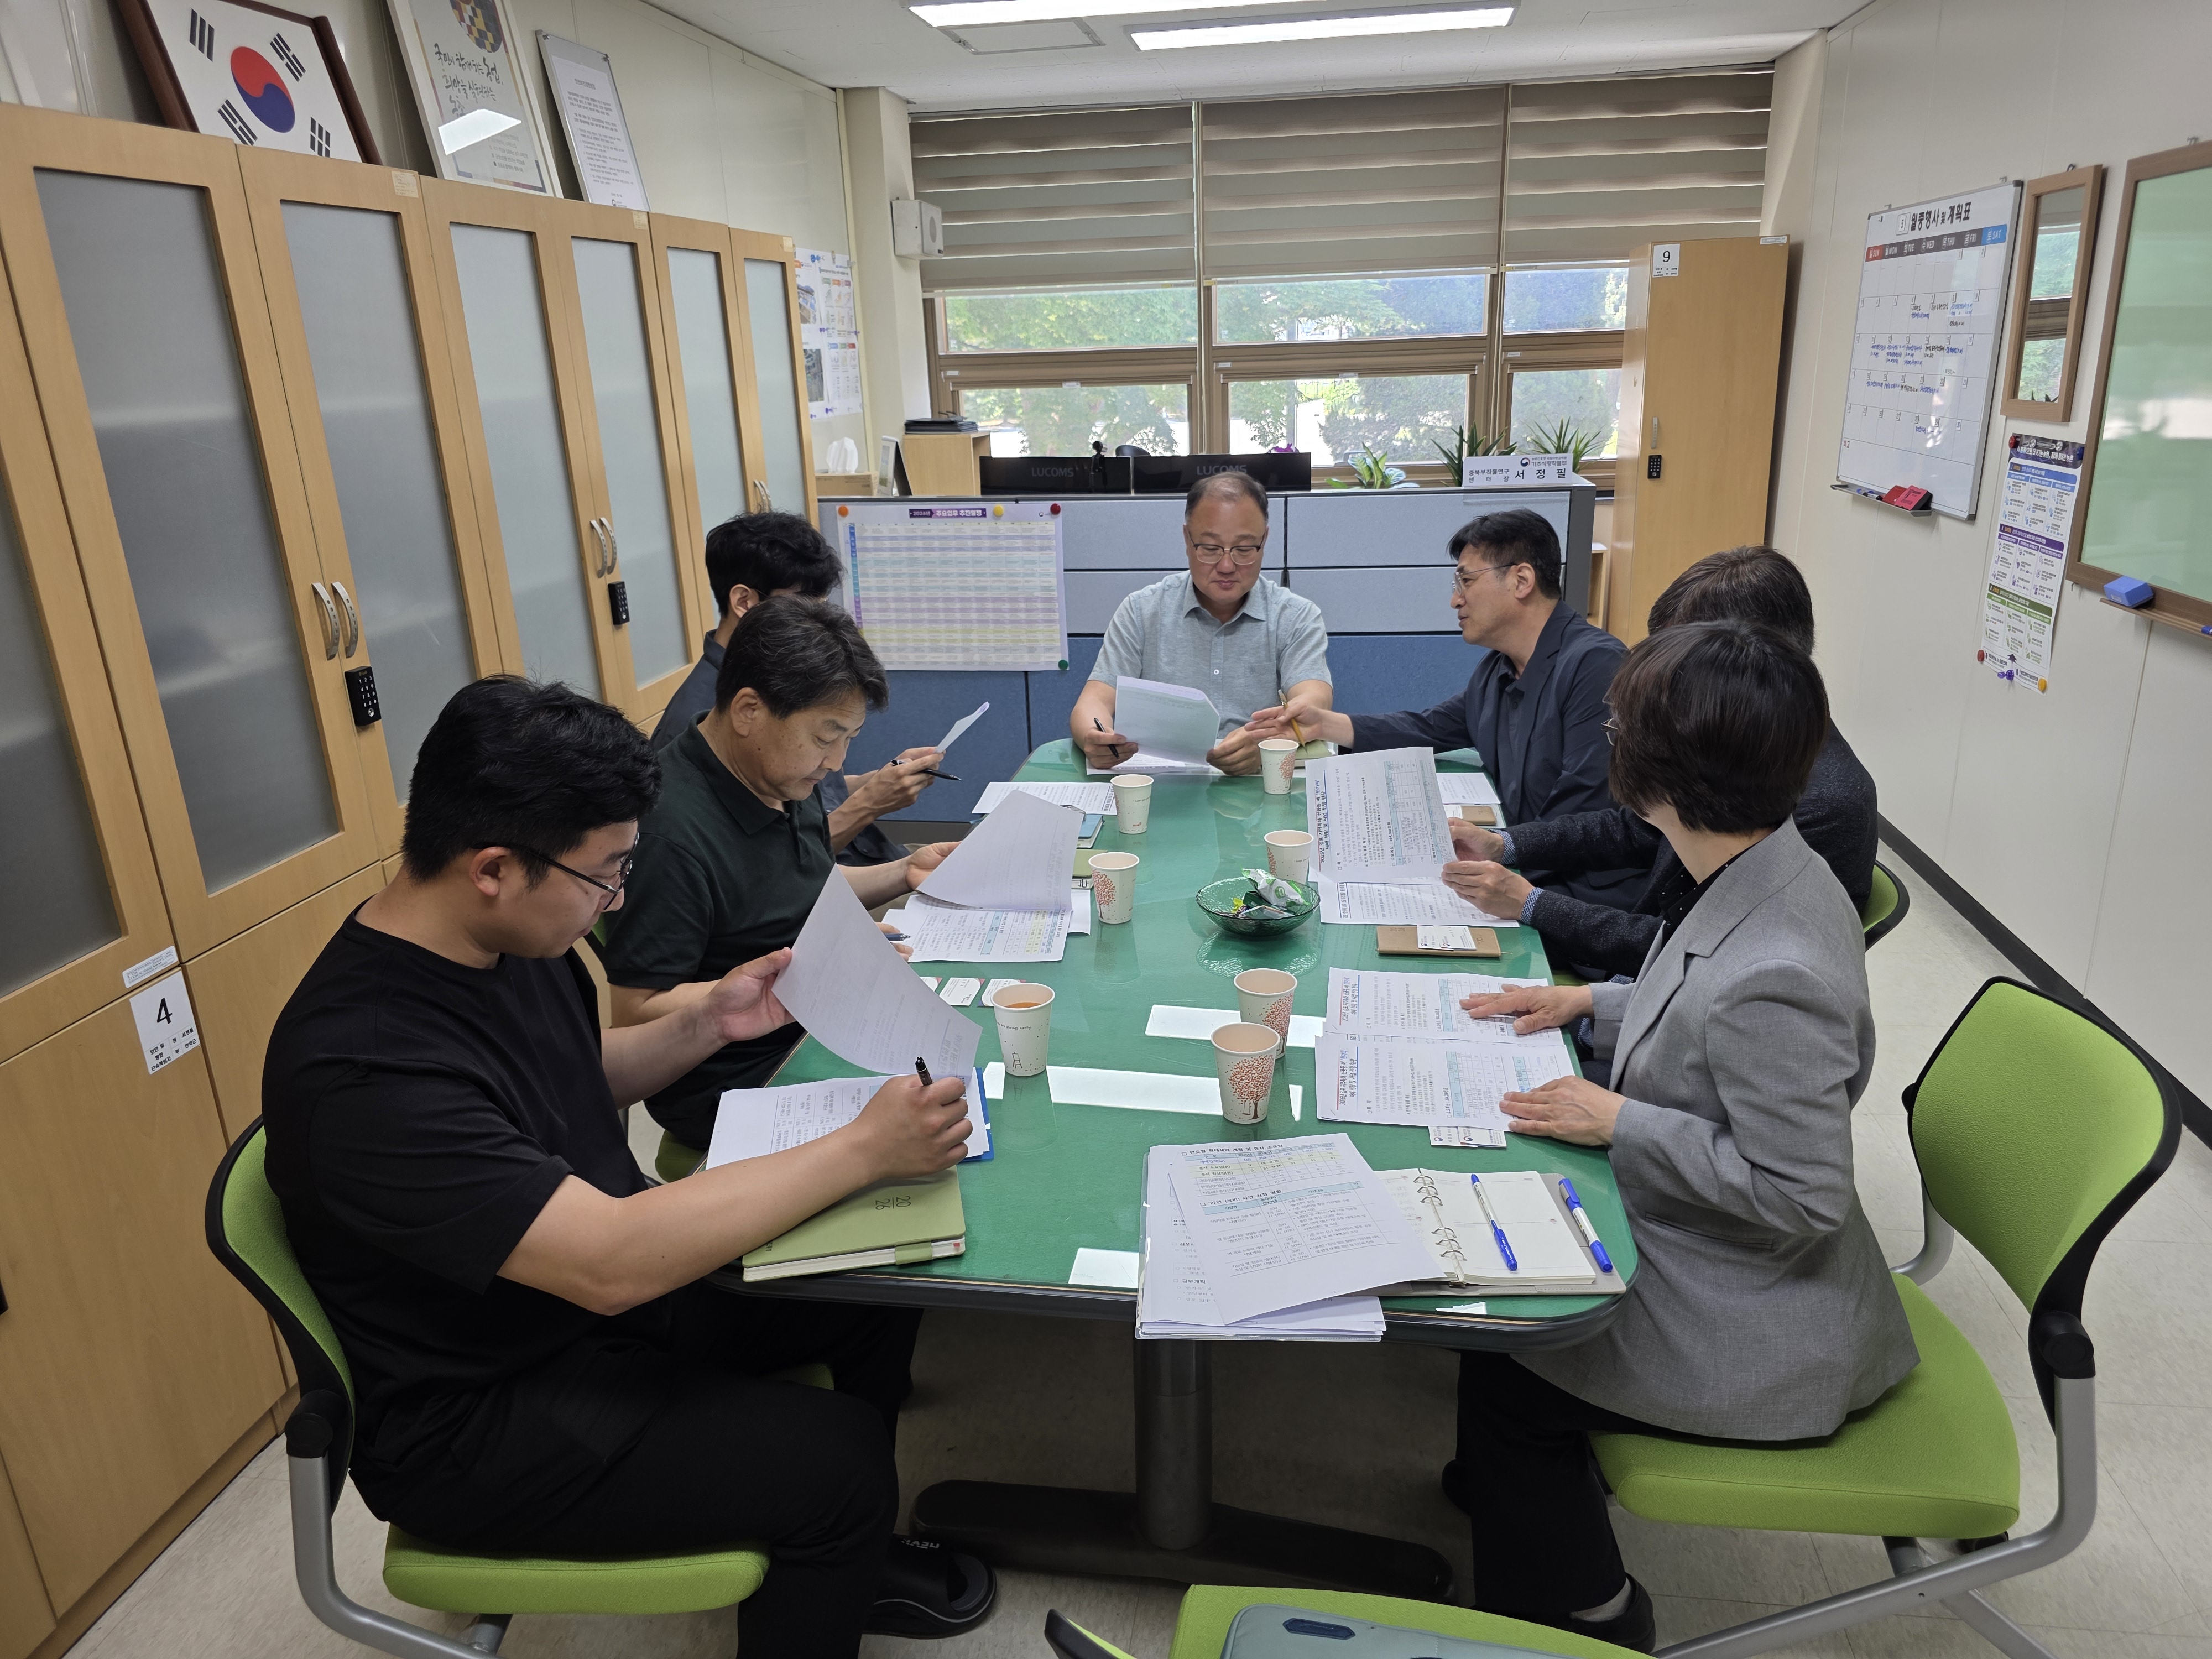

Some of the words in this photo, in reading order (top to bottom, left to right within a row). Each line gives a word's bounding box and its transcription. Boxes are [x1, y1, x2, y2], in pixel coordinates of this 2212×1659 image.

[1911, 208, 1939, 231] 월중행사
[1940, 211, 1946, 225] 및
[1947, 202, 1971, 224] 계획표
[1992, 229, 2001, 239] SAT
[1947, 237, 1955, 246] THU
[1662, 251, 1670, 262] 9
[1031, 467, 1074, 478] LUCOMS
[1197, 465, 1246, 476] LUCOMS
[1515, 469, 1524, 479] 서
[1536, 469, 1545, 479] 정
[1557, 468, 1566, 478] 필
[1321, 791, 1326, 800] 현황
[1321, 802, 1327, 811] 신청
[1322, 812, 1327, 821] 사업
[1323, 830, 1329, 839] 현황
[1319, 837, 1324, 846] 김포
[1324, 840, 1329, 850] 재배
[156, 997, 173, 1024] 4
[875, 1198, 890, 1210] 26
[896, 1196, 911, 1207] 20
